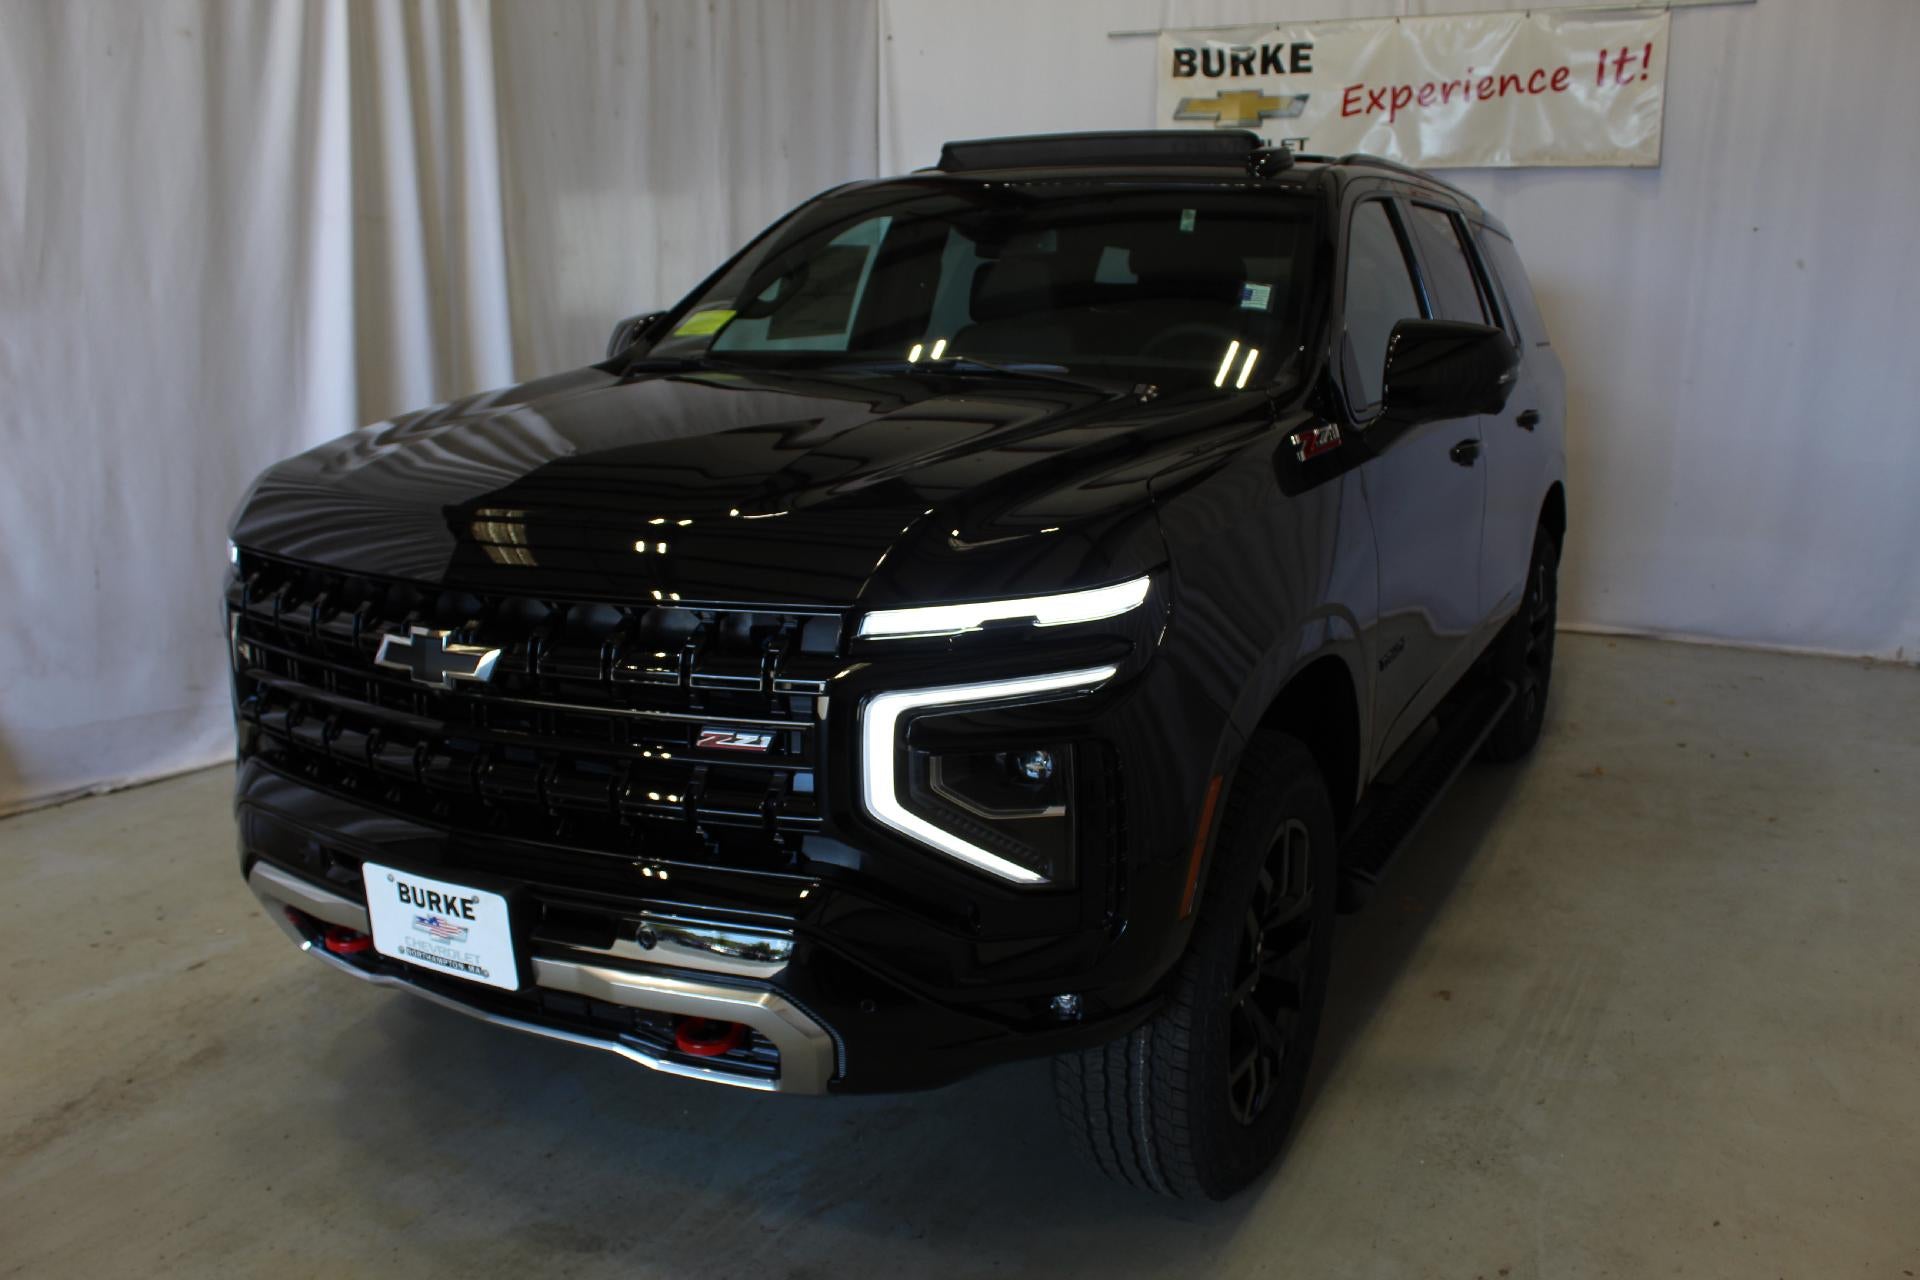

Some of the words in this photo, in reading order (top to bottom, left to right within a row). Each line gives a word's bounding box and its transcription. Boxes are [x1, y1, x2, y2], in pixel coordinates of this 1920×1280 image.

[1172, 43, 1314, 78] BURKE
[1341, 64, 1570, 123] Experience
[1596, 43, 1653, 87] It!
[397, 882, 476, 921] BURKE
[404, 935, 480, 965] CHEVROLET
